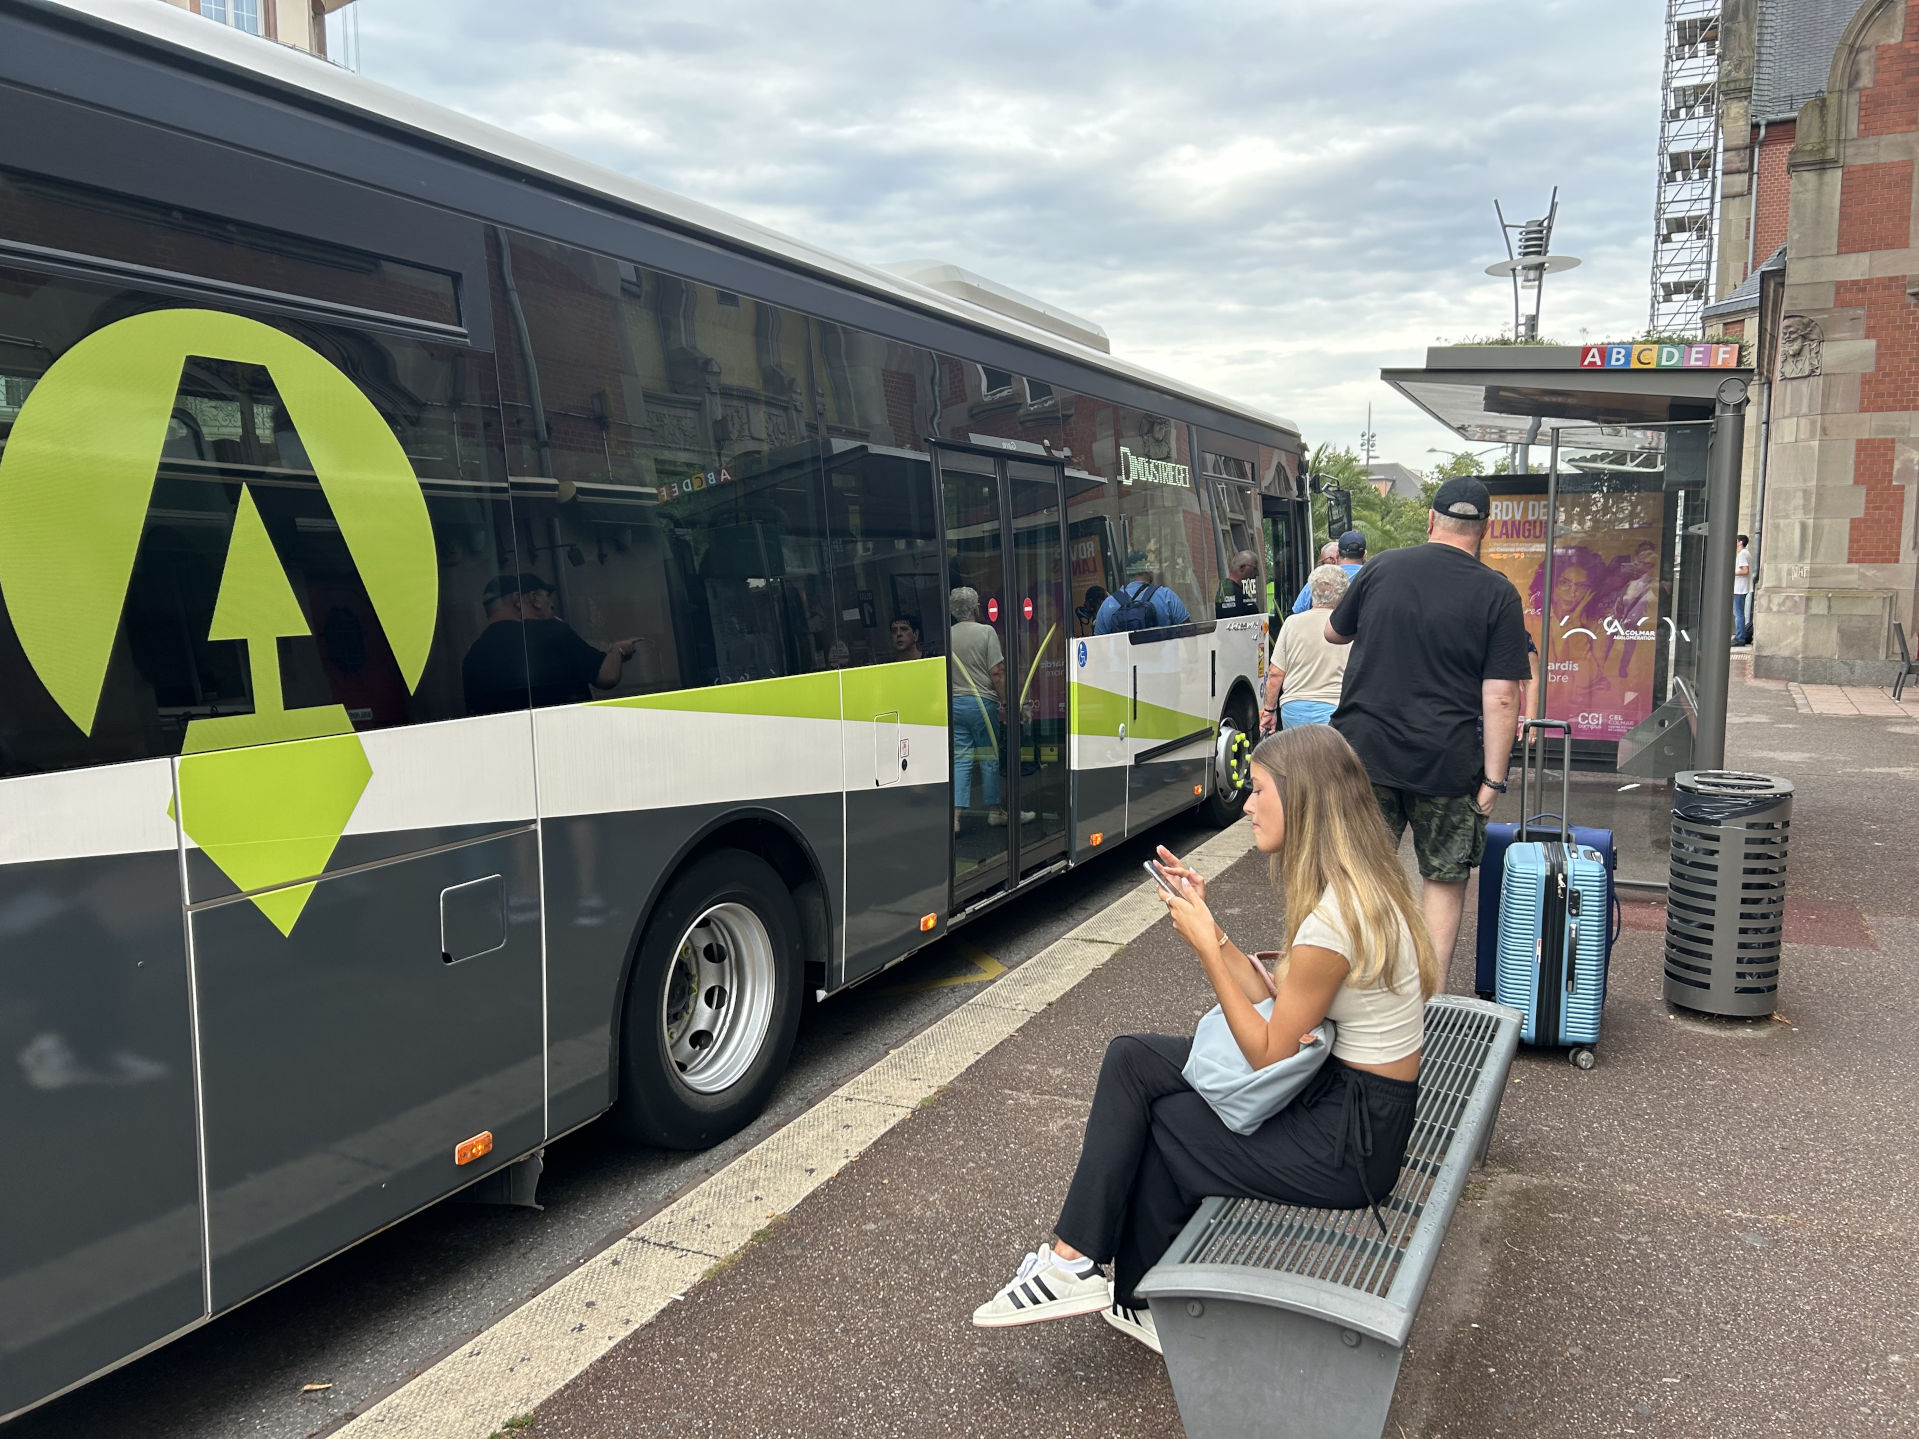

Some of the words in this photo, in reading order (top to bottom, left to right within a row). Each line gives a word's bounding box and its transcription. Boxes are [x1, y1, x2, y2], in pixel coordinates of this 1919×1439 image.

[1490, 500, 1525, 521] RDV
[1528, 500, 1558, 521] DE
[1490, 519, 1560, 540] LANGU
[1624, 629, 1656, 637] COLMAR
[1547, 660, 1579, 672] ardis
[1548, 672, 1569, 684] bre
